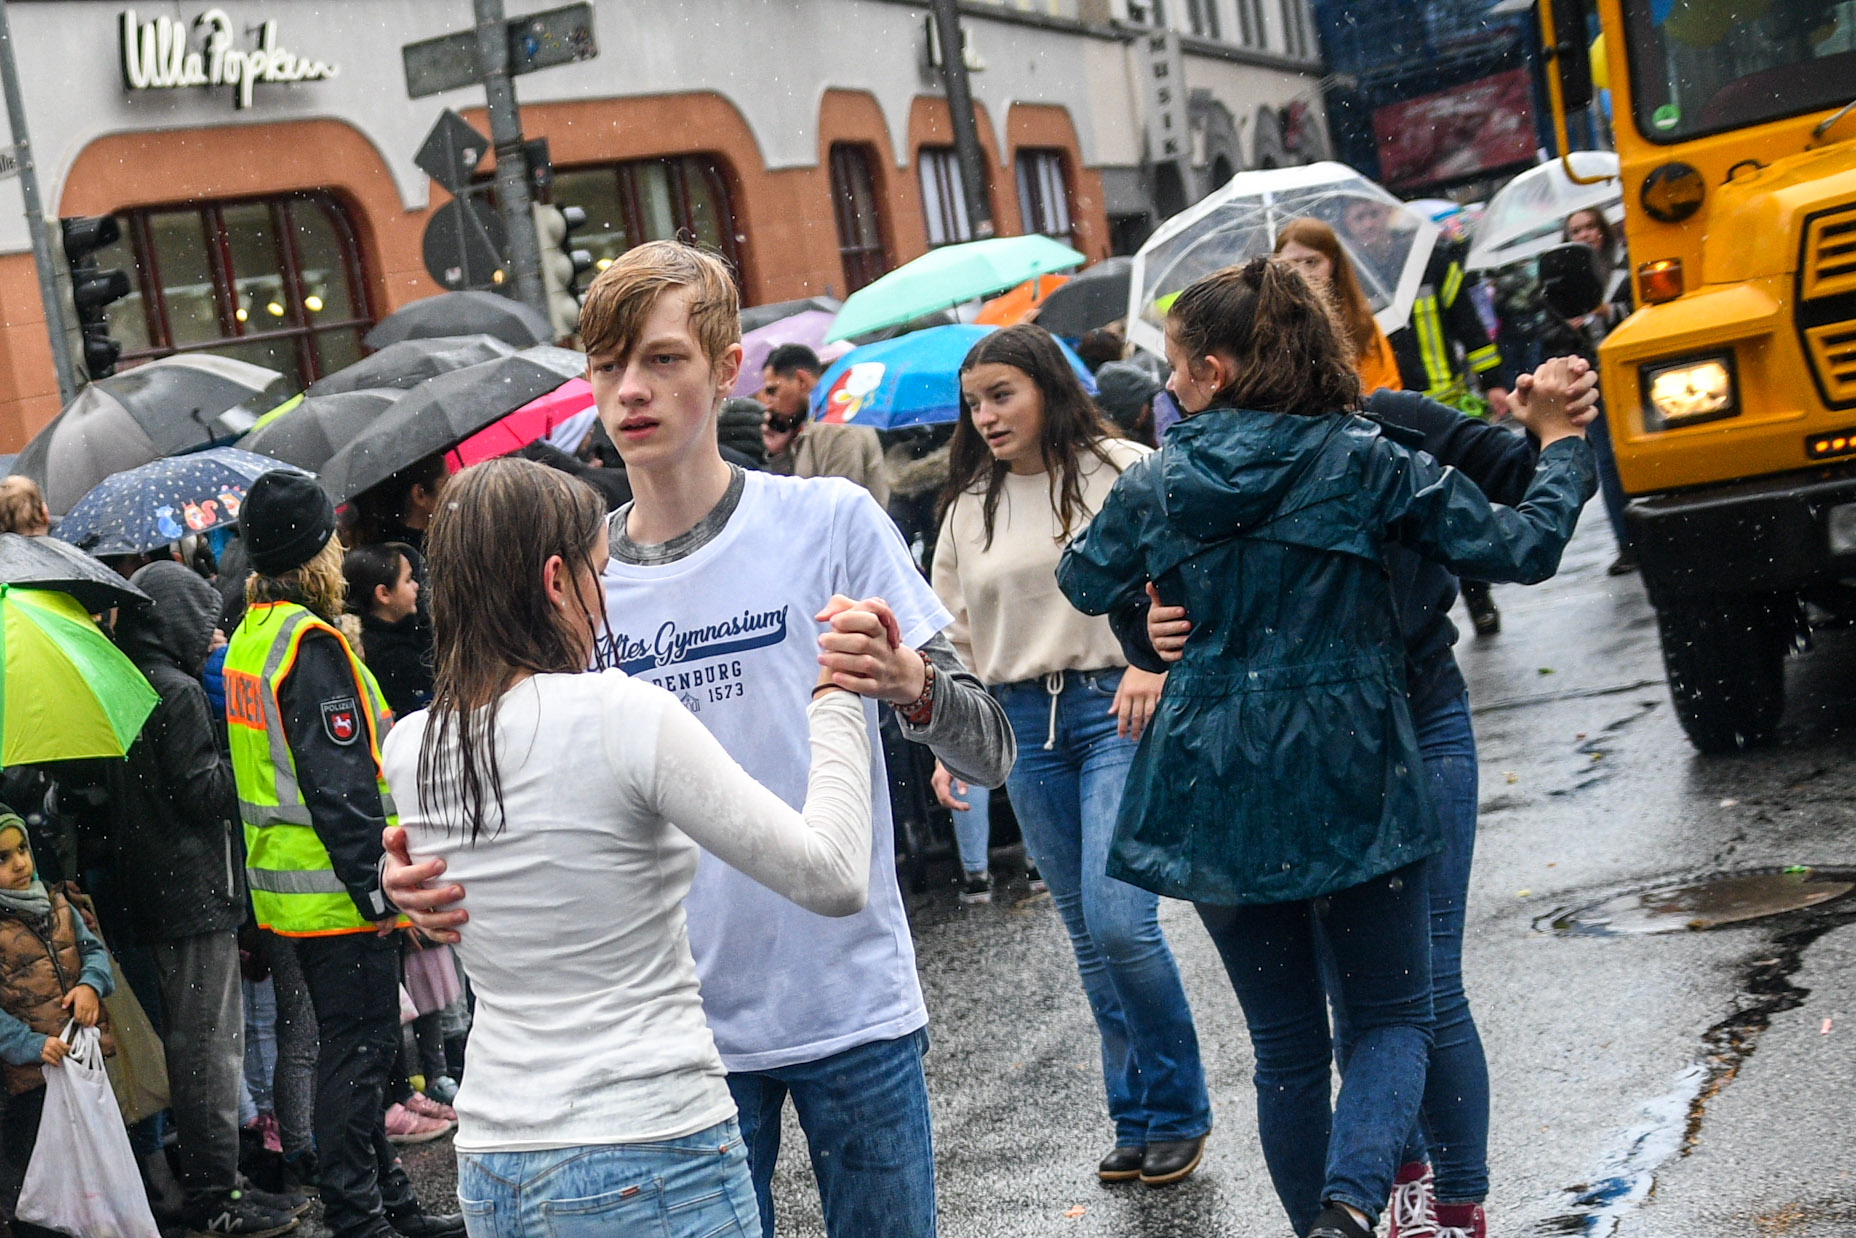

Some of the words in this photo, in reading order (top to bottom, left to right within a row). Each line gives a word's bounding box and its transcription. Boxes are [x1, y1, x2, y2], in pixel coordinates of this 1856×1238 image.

[118, 8, 208, 90] Ulla
[194, 8, 341, 109] Popken
[654, 605, 789, 666] Gymnasium
[652, 661, 742, 692] DENBURG
[323, 702, 353, 712] POLIZEI
[708, 682, 744, 703] 1573
